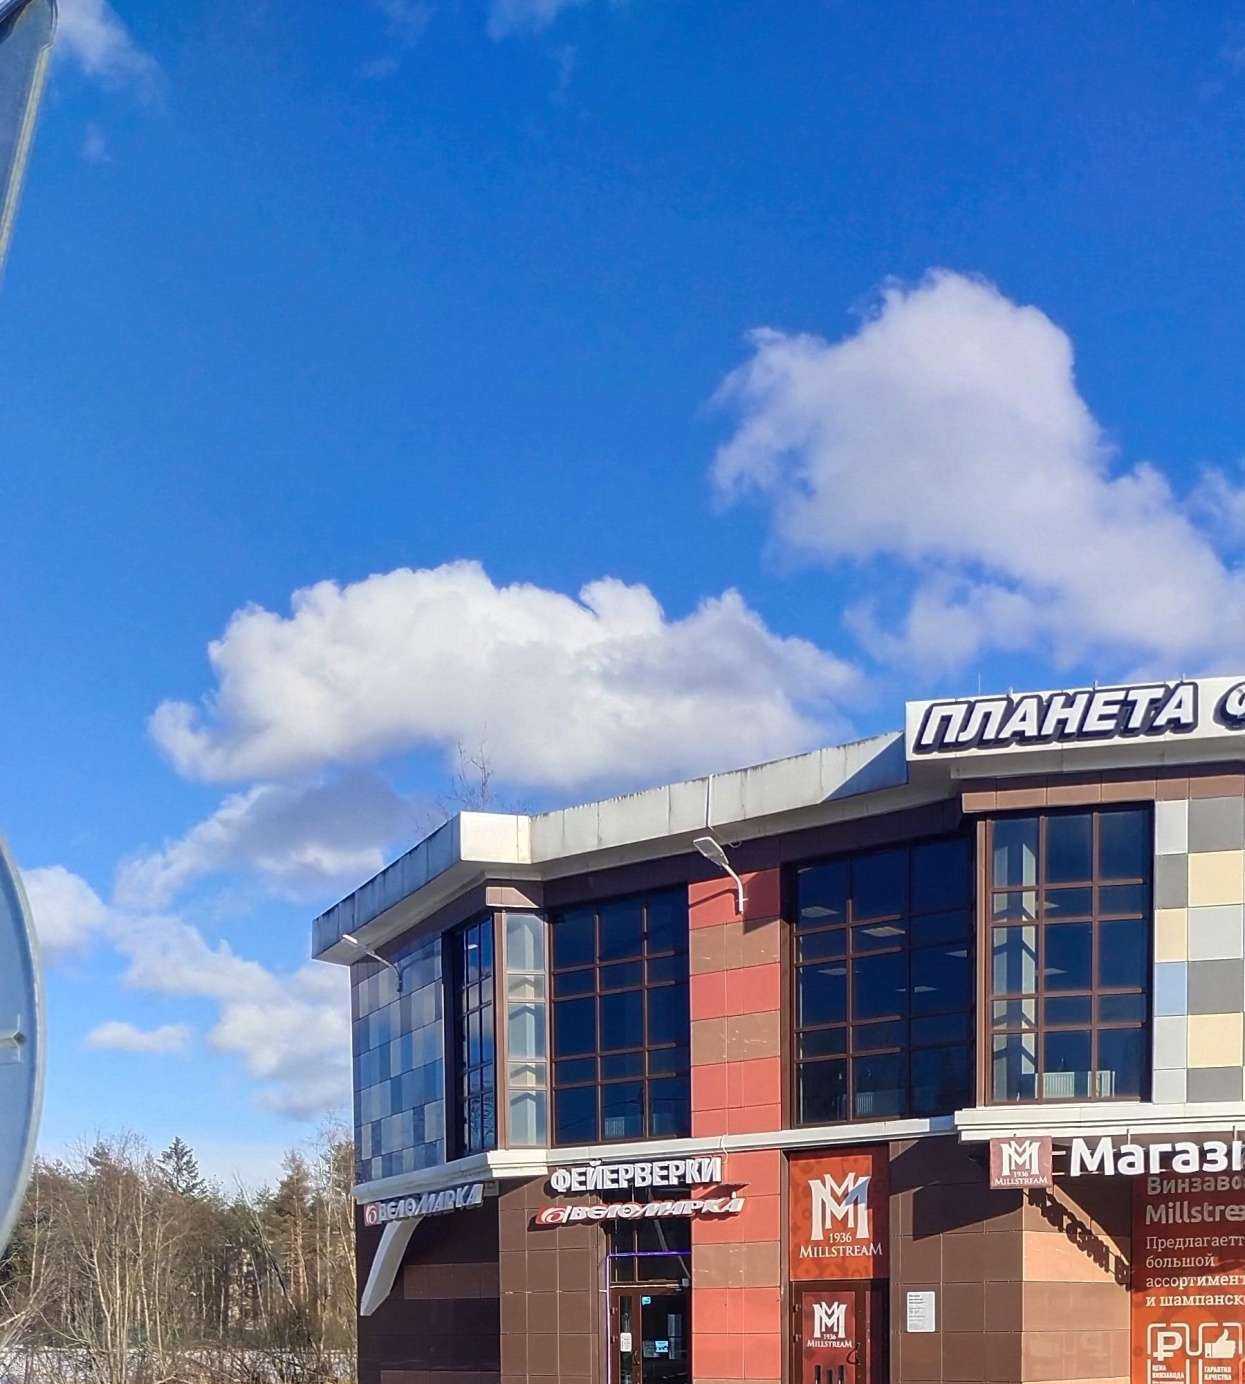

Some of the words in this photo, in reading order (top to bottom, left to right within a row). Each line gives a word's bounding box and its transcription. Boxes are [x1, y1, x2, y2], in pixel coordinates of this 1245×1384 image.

[915, 683, 1198, 753] ПЛАНЕТА
[550, 1156, 722, 1193] ФЕЙЕРВЕРКИ
[1147, 1176, 1245, 1195] Винзаво
[829, 1232, 852, 1243] 1936
[1146, 1253, 1216, 1268] большой
[1145, 1296, 1156, 1307] и
